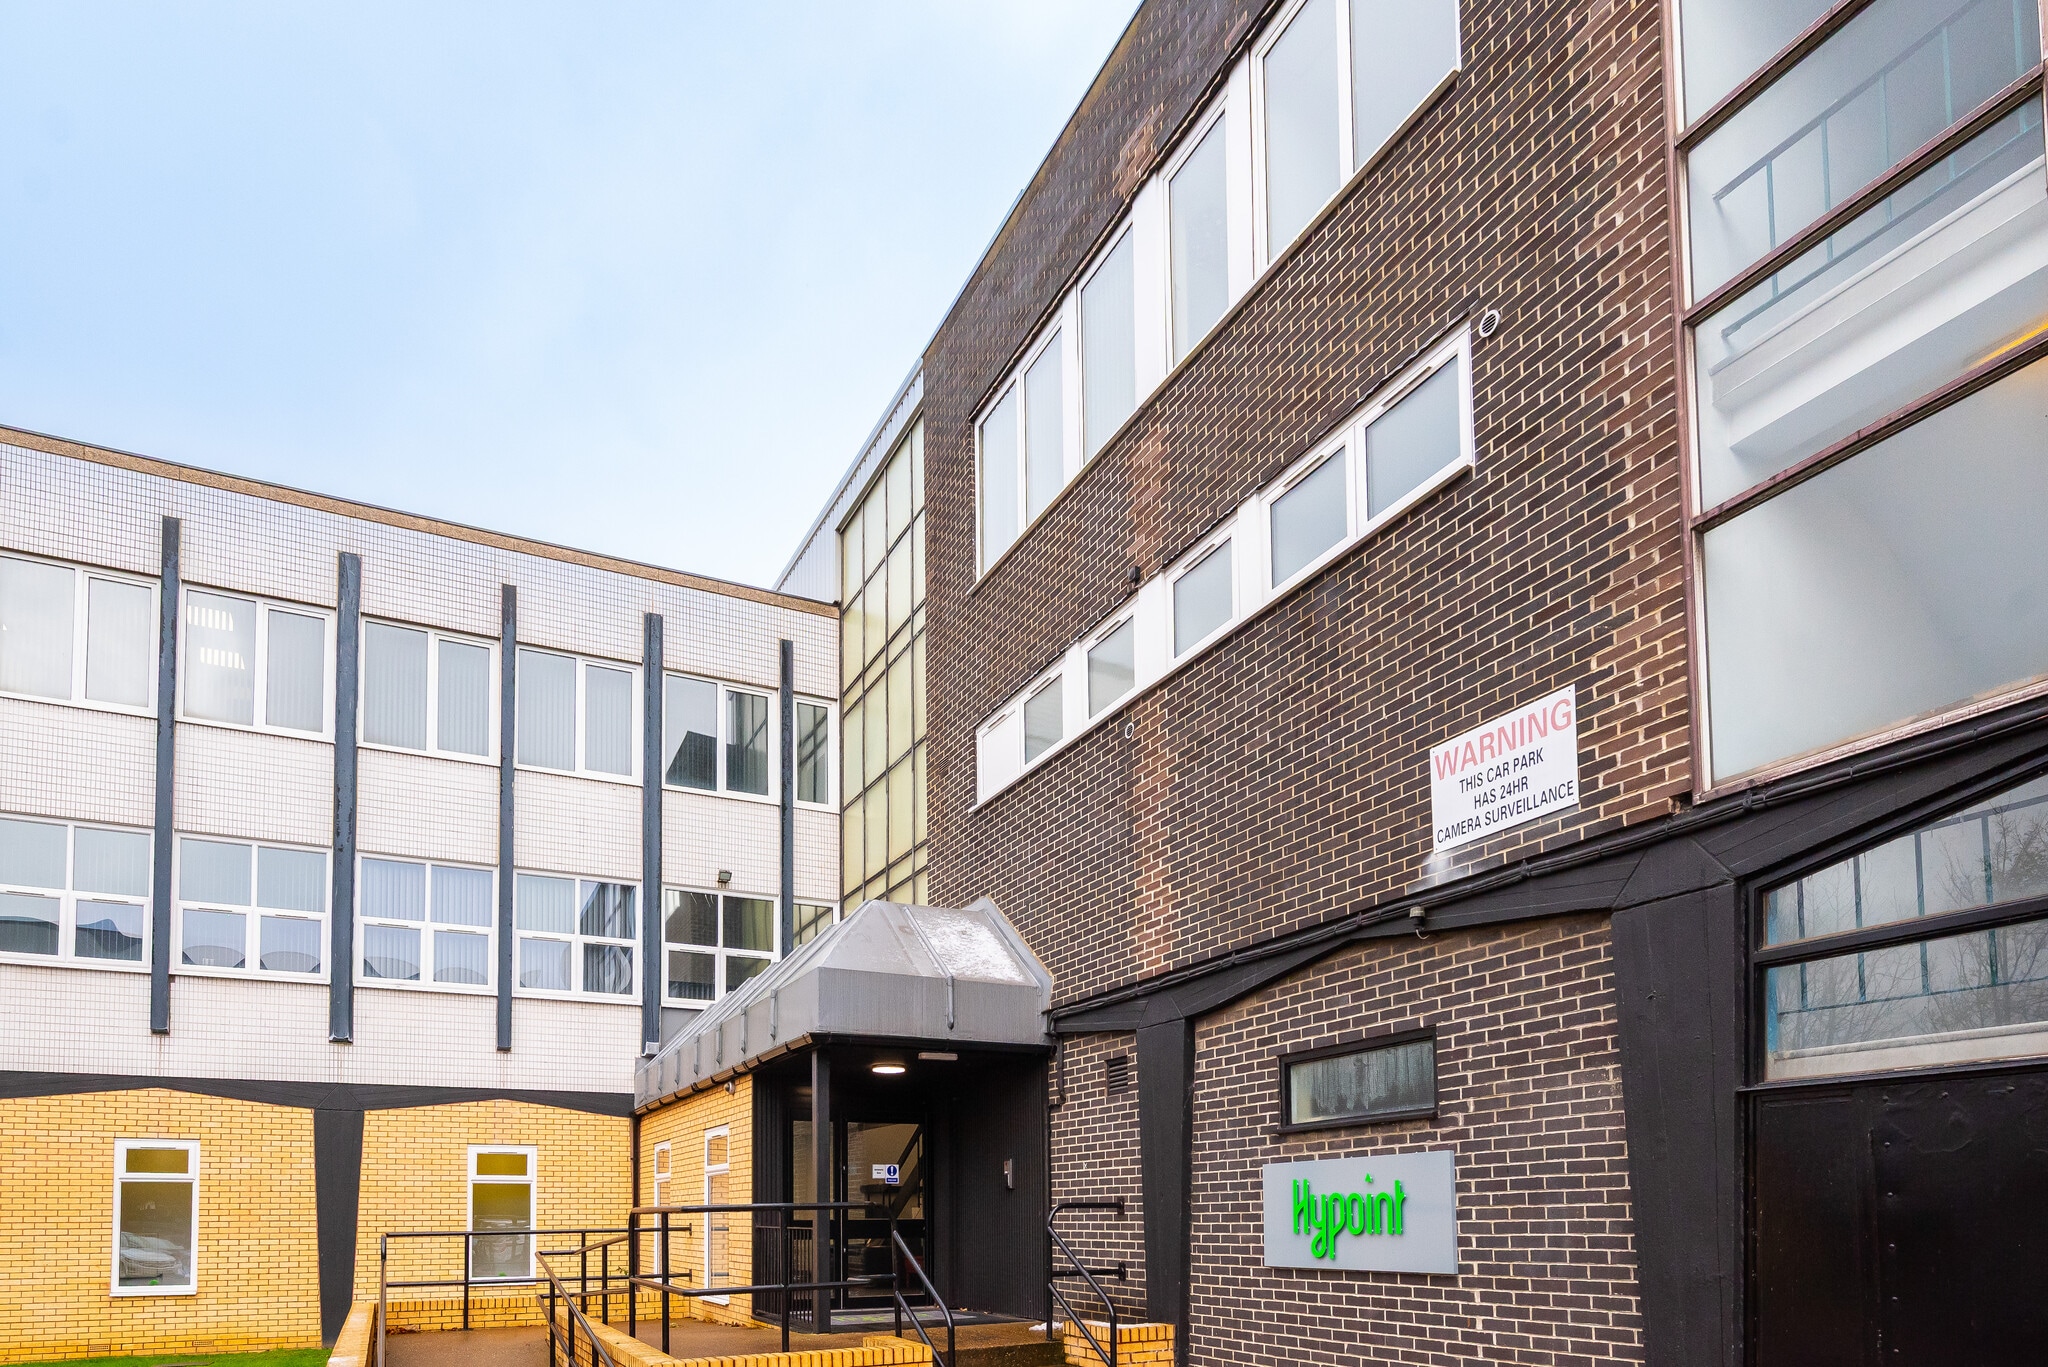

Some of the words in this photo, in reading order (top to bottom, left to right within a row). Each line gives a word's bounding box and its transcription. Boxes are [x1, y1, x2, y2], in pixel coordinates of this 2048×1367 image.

[1435, 699, 1572, 781] WARNING
[1459, 772, 1483, 794] THIS
[1487, 762, 1510, 782] CAR
[1513, 748, 1544, 773] PARK
[1437, 815, 1481, 843] CAMERA
[1484, 781, 1574, 826] SURVEILLANCE
[1474, 789, 1496, 809] HAS
[1500, 776, 1528, 802] 24HR
[1292, 1173, 1406, 1259] Hypoint
